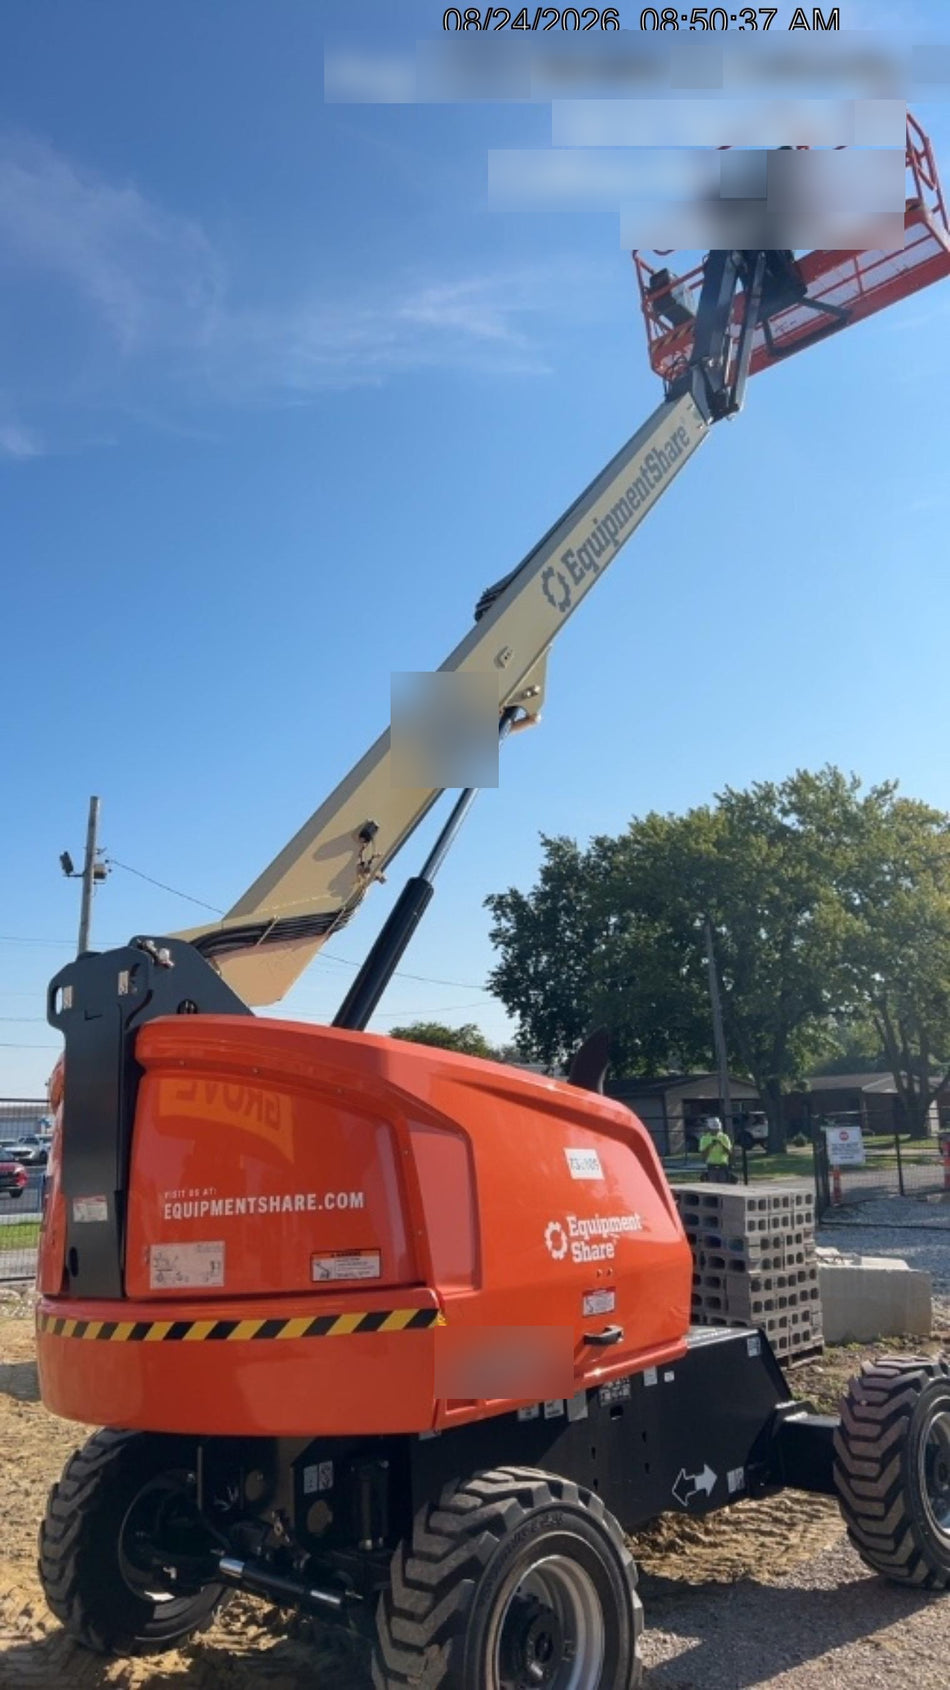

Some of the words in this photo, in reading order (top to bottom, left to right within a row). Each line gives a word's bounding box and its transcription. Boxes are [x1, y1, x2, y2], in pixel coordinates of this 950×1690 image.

[561, 425, 690, 586] EquipmentShare
[164, 1192, 364, 1220] EQUIPMENTSHARE.COM
[567, 1213, 642, 1240] Equipment
[571, 1241, 615, 1263] Share
